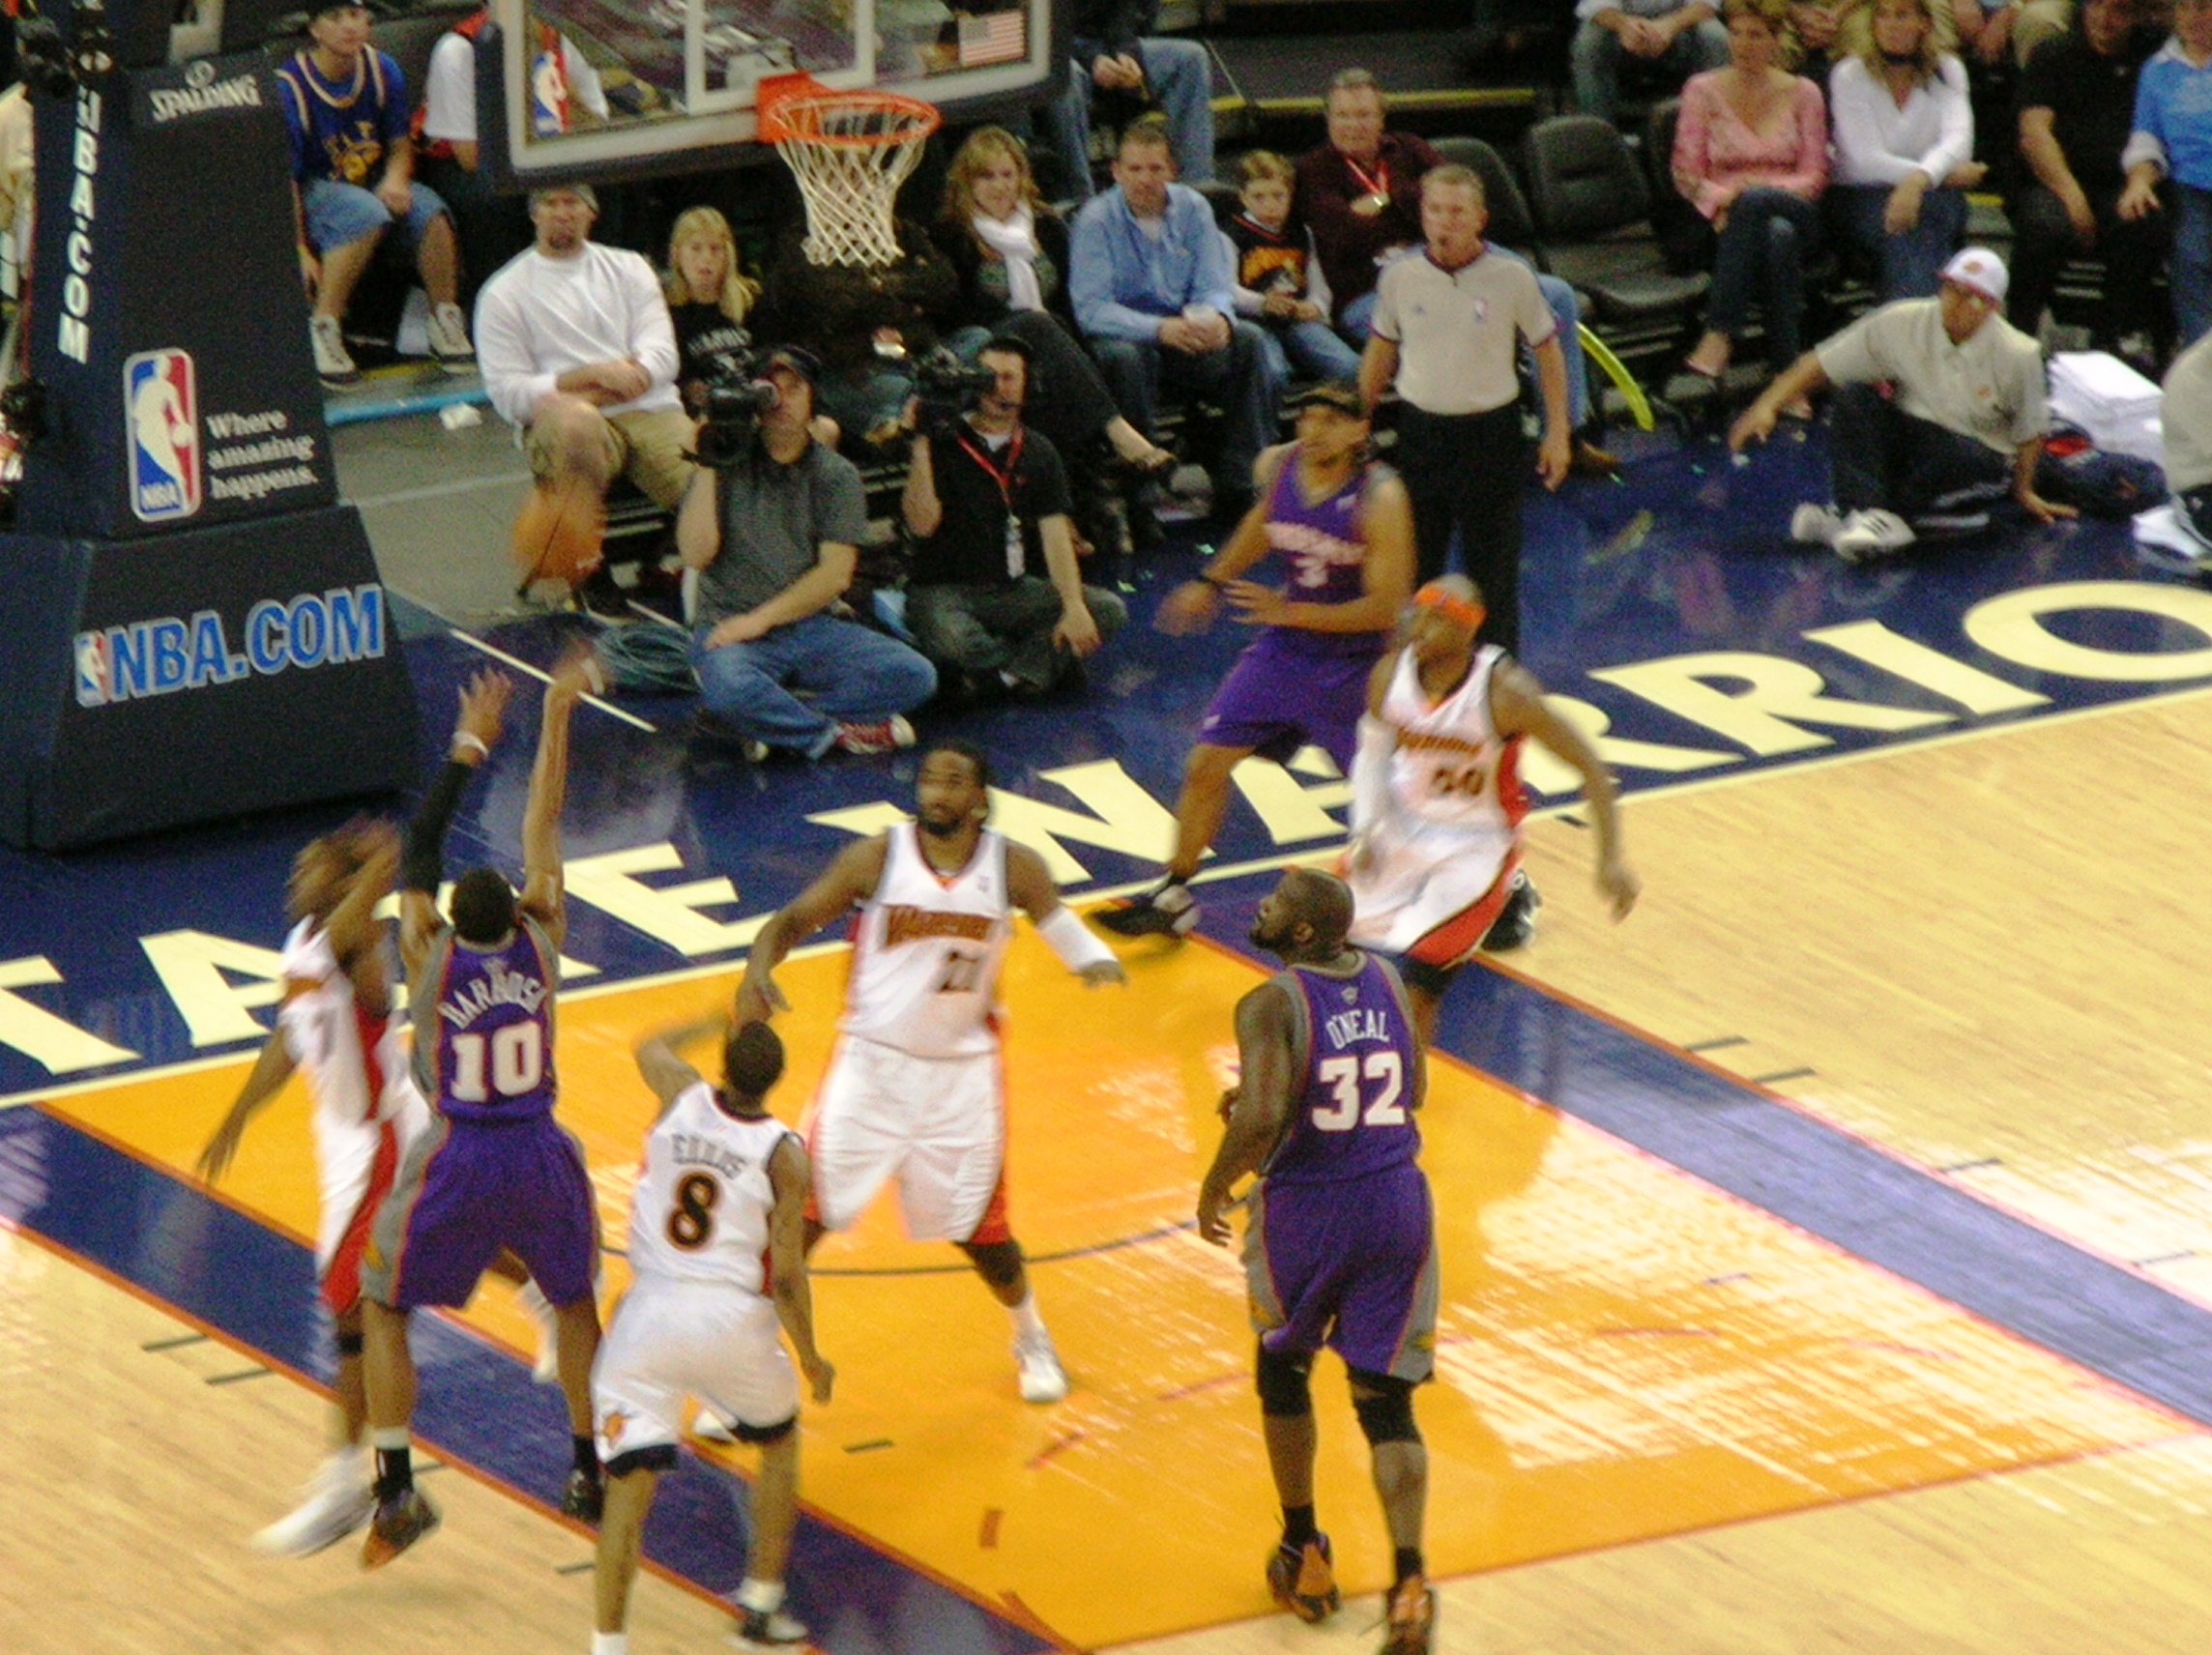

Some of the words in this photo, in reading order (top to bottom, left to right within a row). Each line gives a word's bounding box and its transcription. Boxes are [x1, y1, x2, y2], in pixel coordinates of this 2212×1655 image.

[150, 73, 262, 124] SPALDING
[206, 410, 288, 439] Where
[207, 435, 315, 470] amazing
[105, 583, 386, 703] NBA.COM
[0, 842, 785, 1075] TAE
[451, 1020, 542, 1102] 10
[1325, 1009, 1390, 1050] O'NEAL
[1312, 1051, 1406, 1131] 32
[667, 1172, 719, 1252] 8
